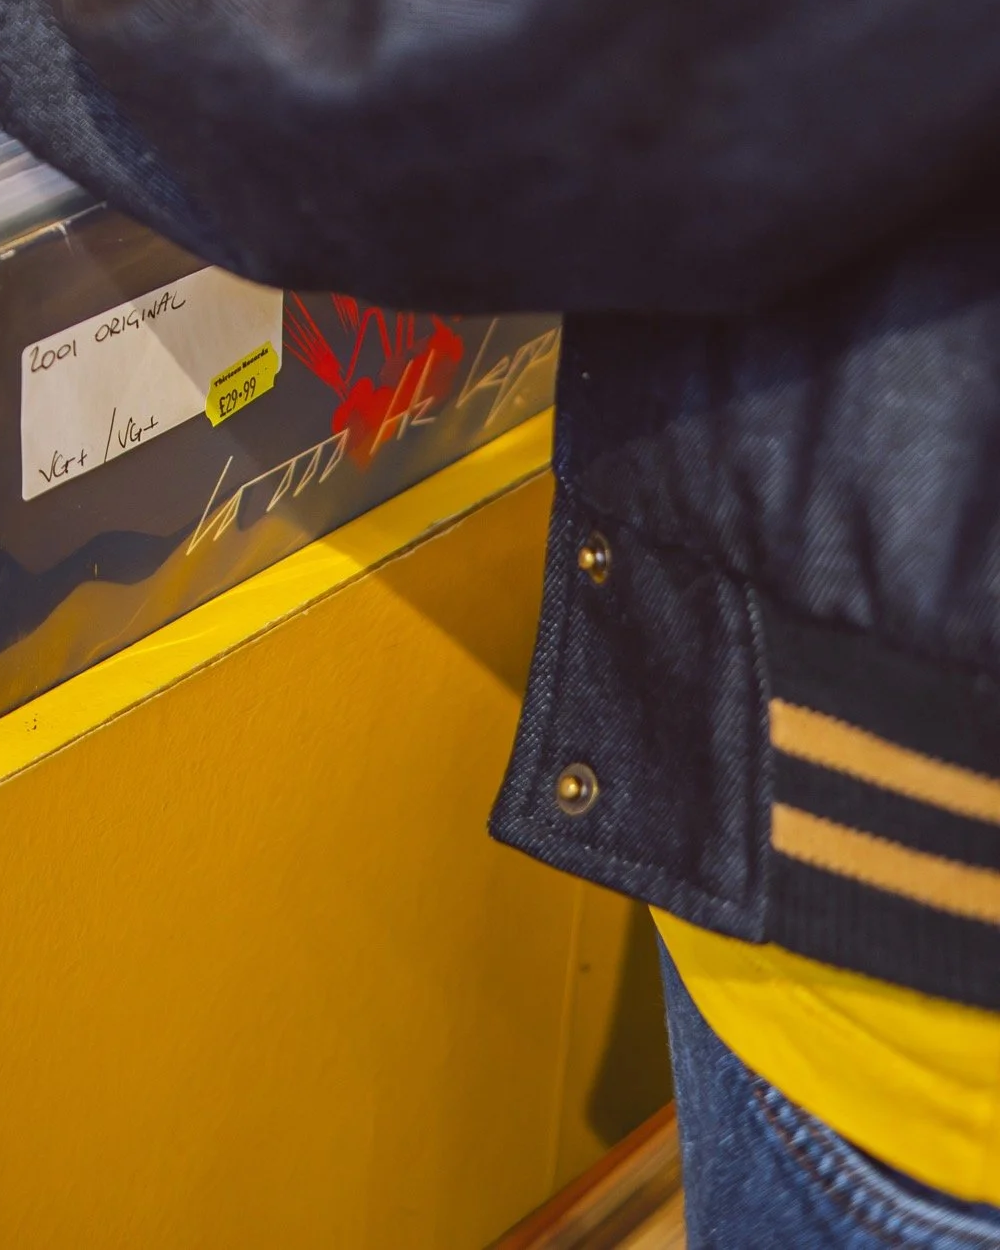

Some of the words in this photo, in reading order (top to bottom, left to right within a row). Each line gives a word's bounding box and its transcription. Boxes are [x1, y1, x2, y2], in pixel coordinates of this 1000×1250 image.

[28, 339, 78, 374] 2001
[93, 291, 187, 343] ORIGINAL
[213, 365, 242, 387] Thirteen
[242, 348, 269, 369] Records
[219, 377, 257, 418] £29.99
[38, 448, 88, 483] VG+
[117, 415, 159, 449] VG+
